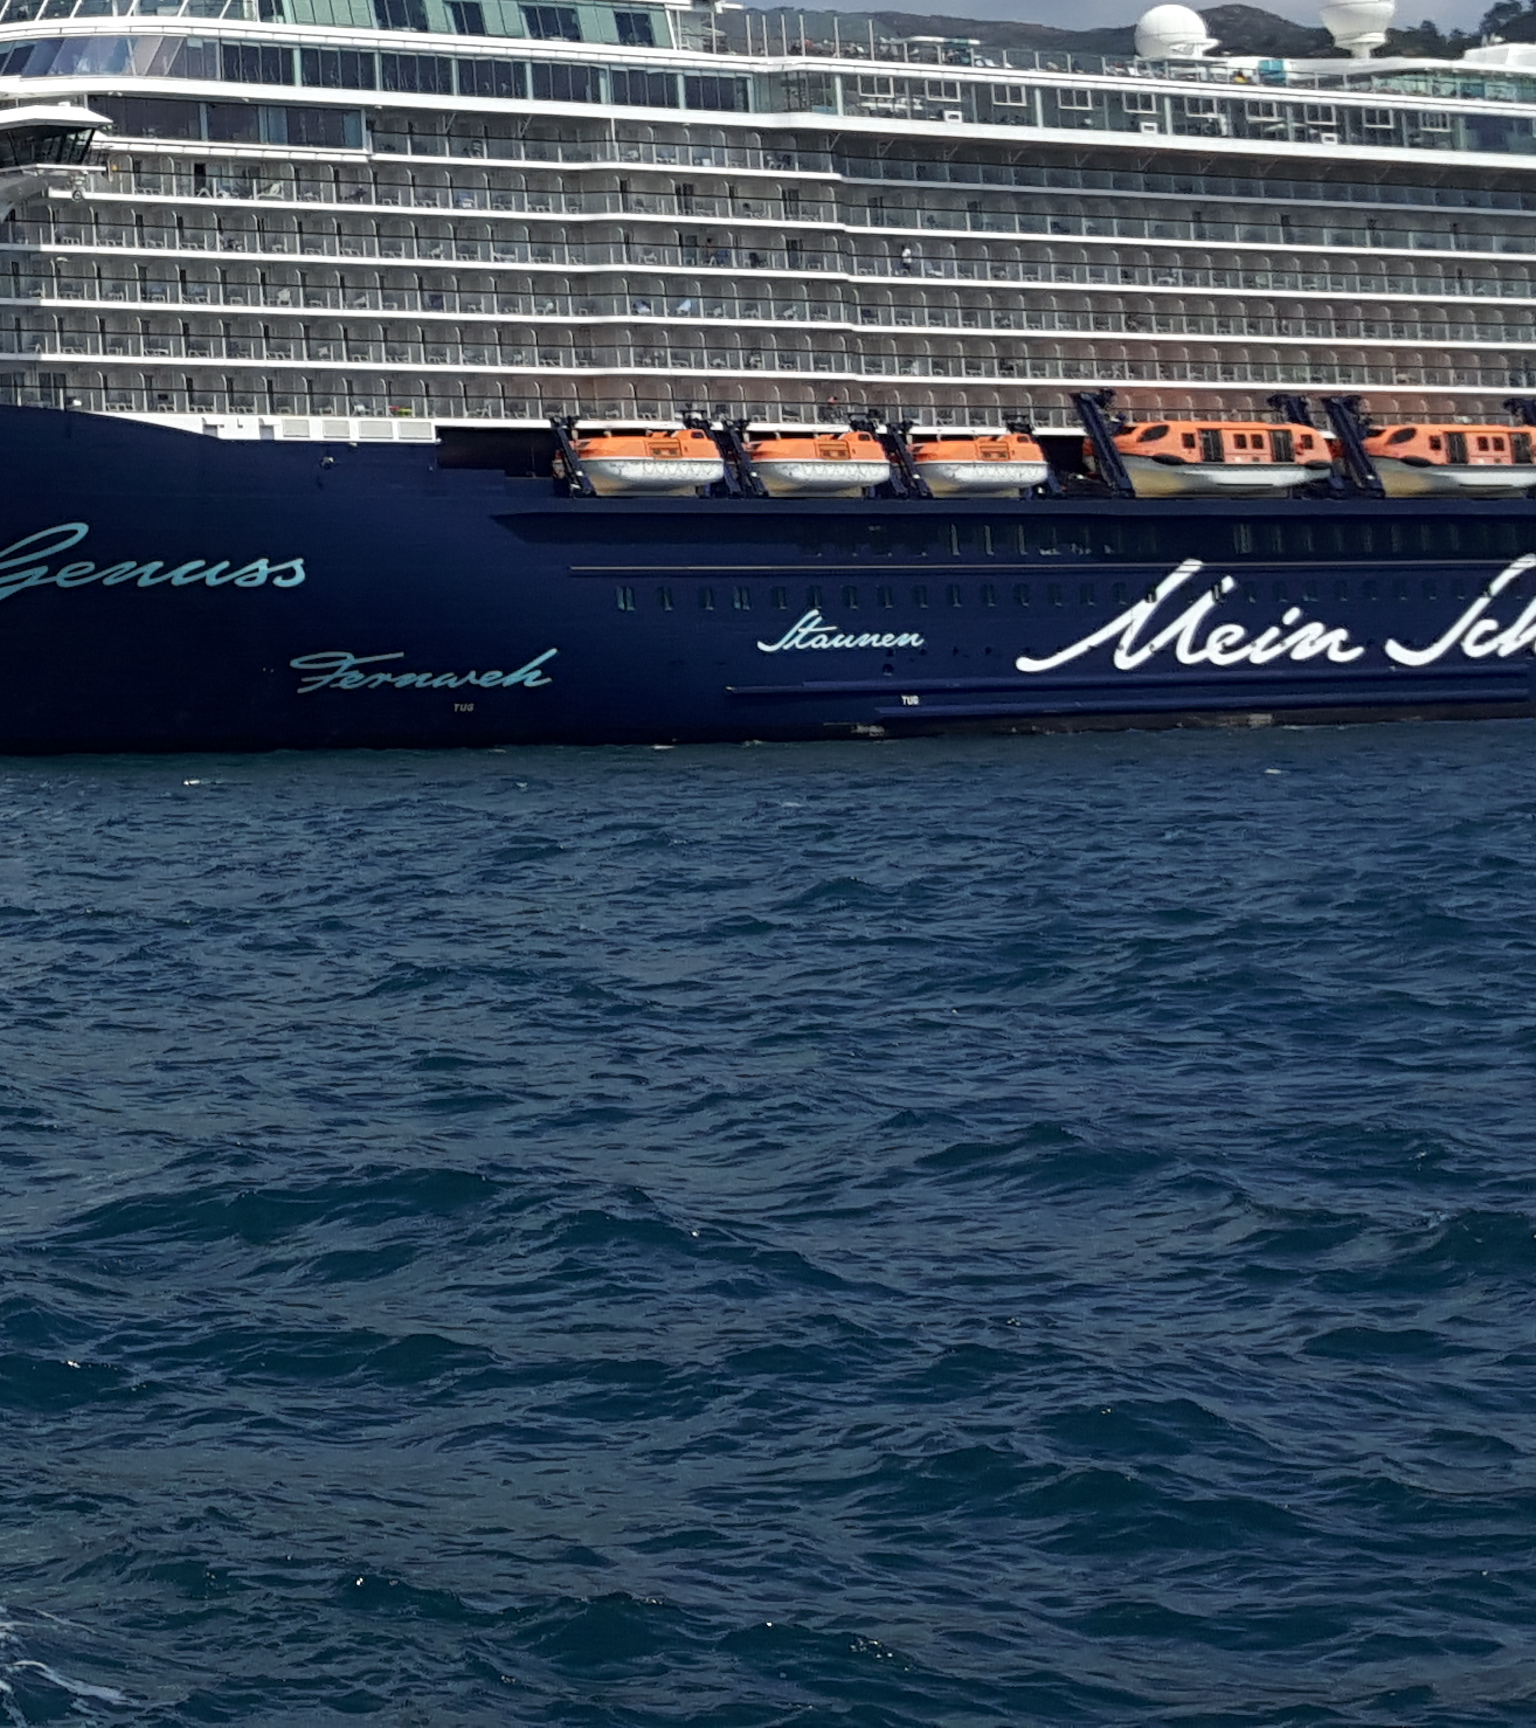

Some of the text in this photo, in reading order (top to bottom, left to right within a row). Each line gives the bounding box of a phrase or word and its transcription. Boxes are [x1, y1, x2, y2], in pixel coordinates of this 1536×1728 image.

[757, 608, 925, 652] Staunen
[1016, 558, 1365, 672] Mein
[289, 647, 558, 694] Fernweh
